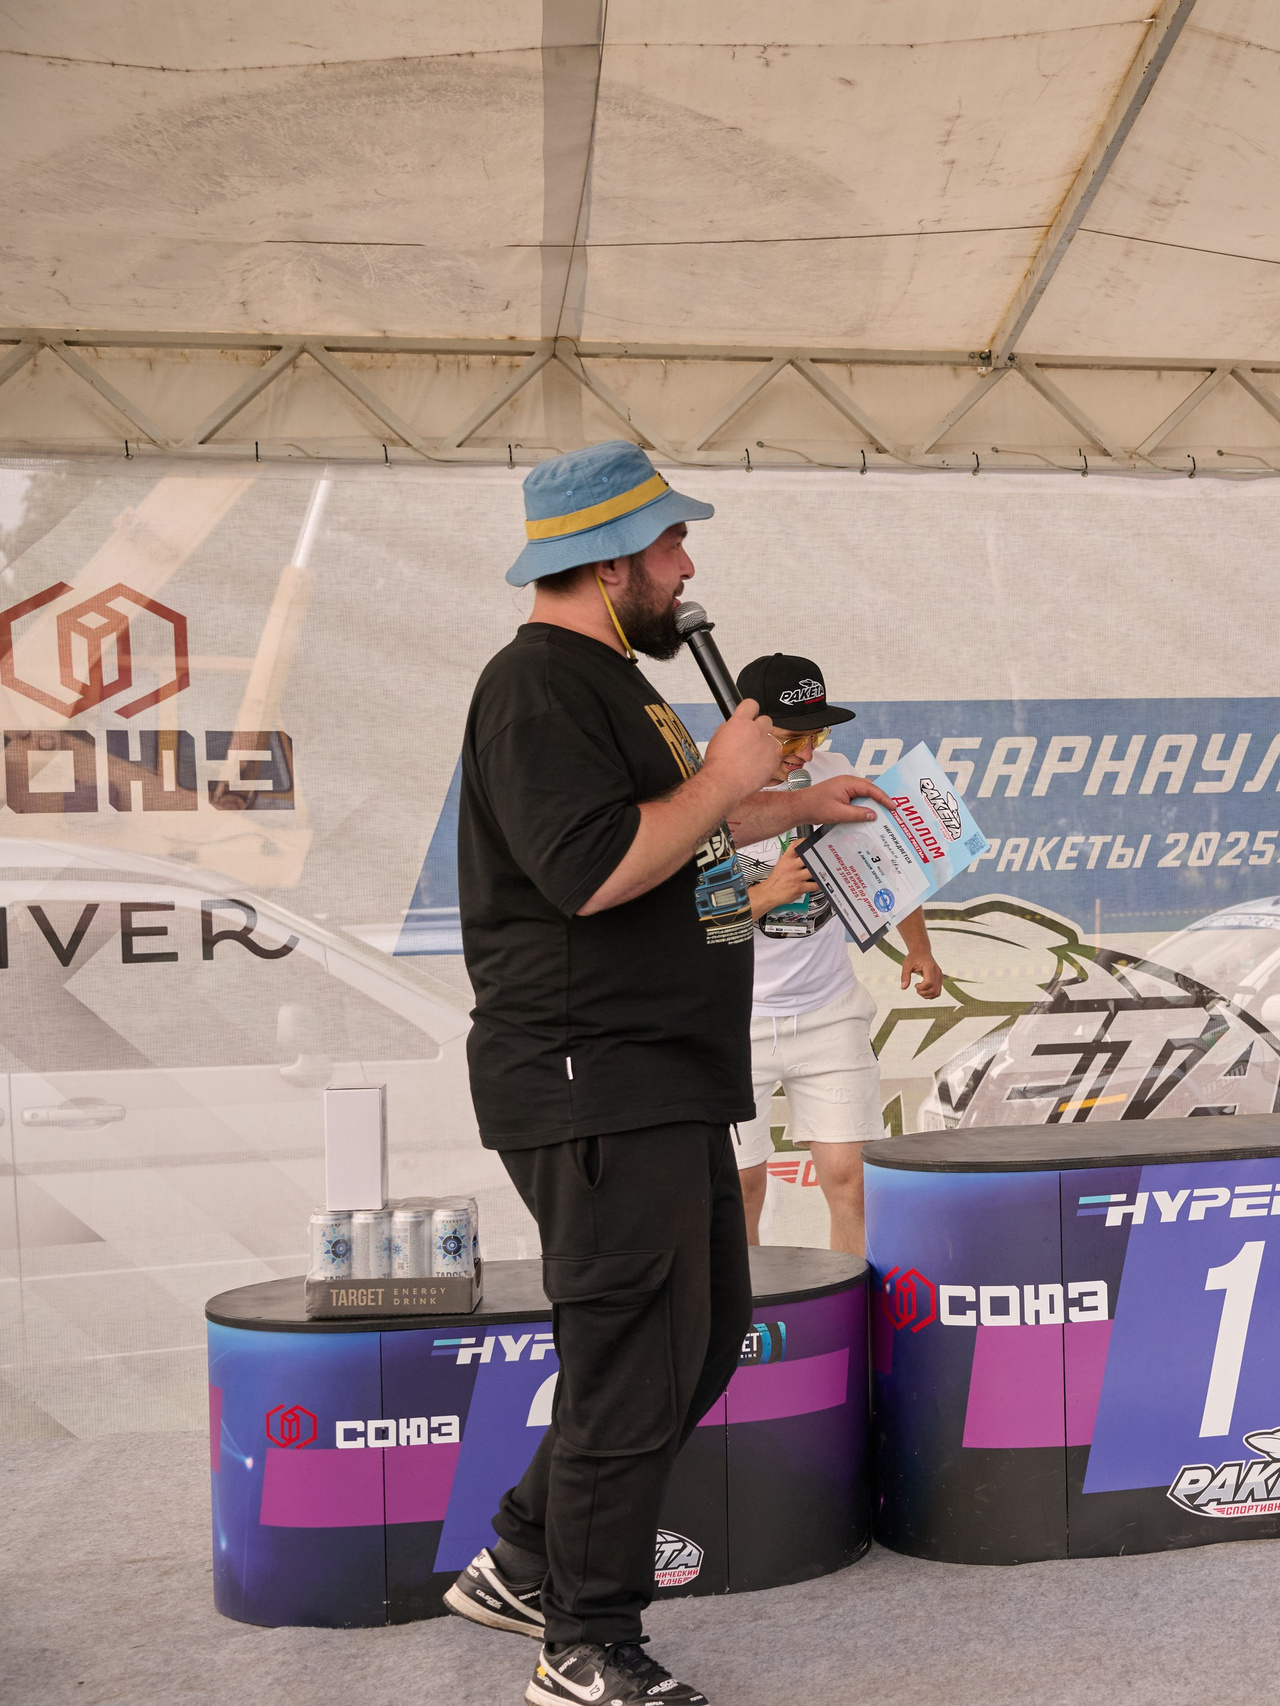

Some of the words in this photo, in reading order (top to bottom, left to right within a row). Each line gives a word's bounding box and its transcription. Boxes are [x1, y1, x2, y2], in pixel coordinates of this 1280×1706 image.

[892, 796, 945, 859] ДИПЛОМ
[967, 834, 1152, 872] РАКЕТЫ
[330, 1289, 384, 1306] TARGET
[393, 1287, 447, 1296] ENERGY
[393, 1298, 437, 1306] DRINK
[939, 1280, 1109, 1326] СОЮЗ
[1199, 1240, 1265, 1437] 1
[336, 1415, 460, 1449] СОЮЗ
[659, 1578, 684, 1586] КЛУБ
